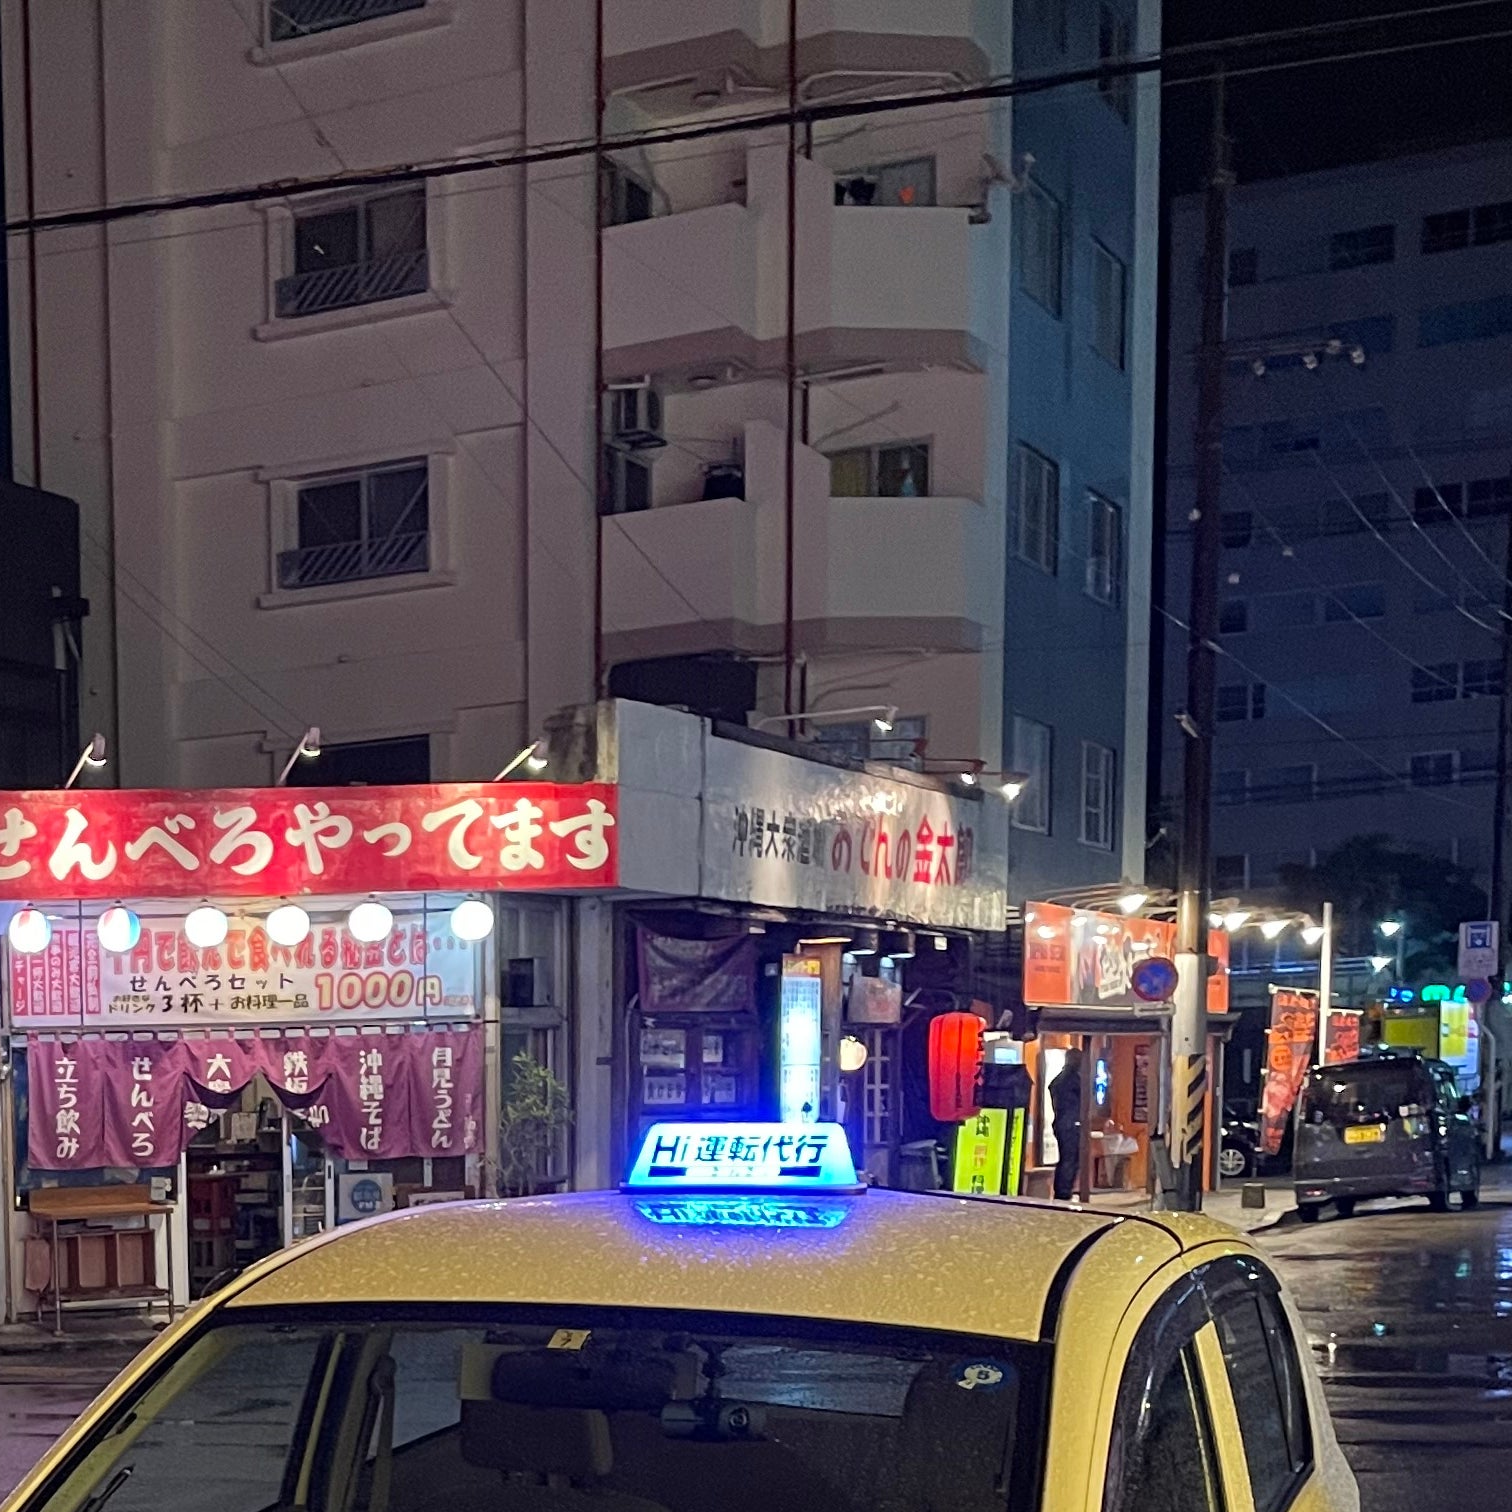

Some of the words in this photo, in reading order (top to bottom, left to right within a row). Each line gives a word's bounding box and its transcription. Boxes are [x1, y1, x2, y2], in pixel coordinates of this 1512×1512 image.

[108, 1001, 156, 1014] ドリンク
[129, 973, 294, 992] せんべろセット
[315, 969, 442, 1011] 1000円
[54, 1056, 81, 1159] 立ち飲み
[131, 1056, 155, 1157] せんべろ
[359, 1048, 384, 1150] 沖縄そば
[431, 1046, 454, 1149] 月見うどん
[651, 1135, 691, 1164] Hi
[694, 1134, 829, 1164] 運転代行
